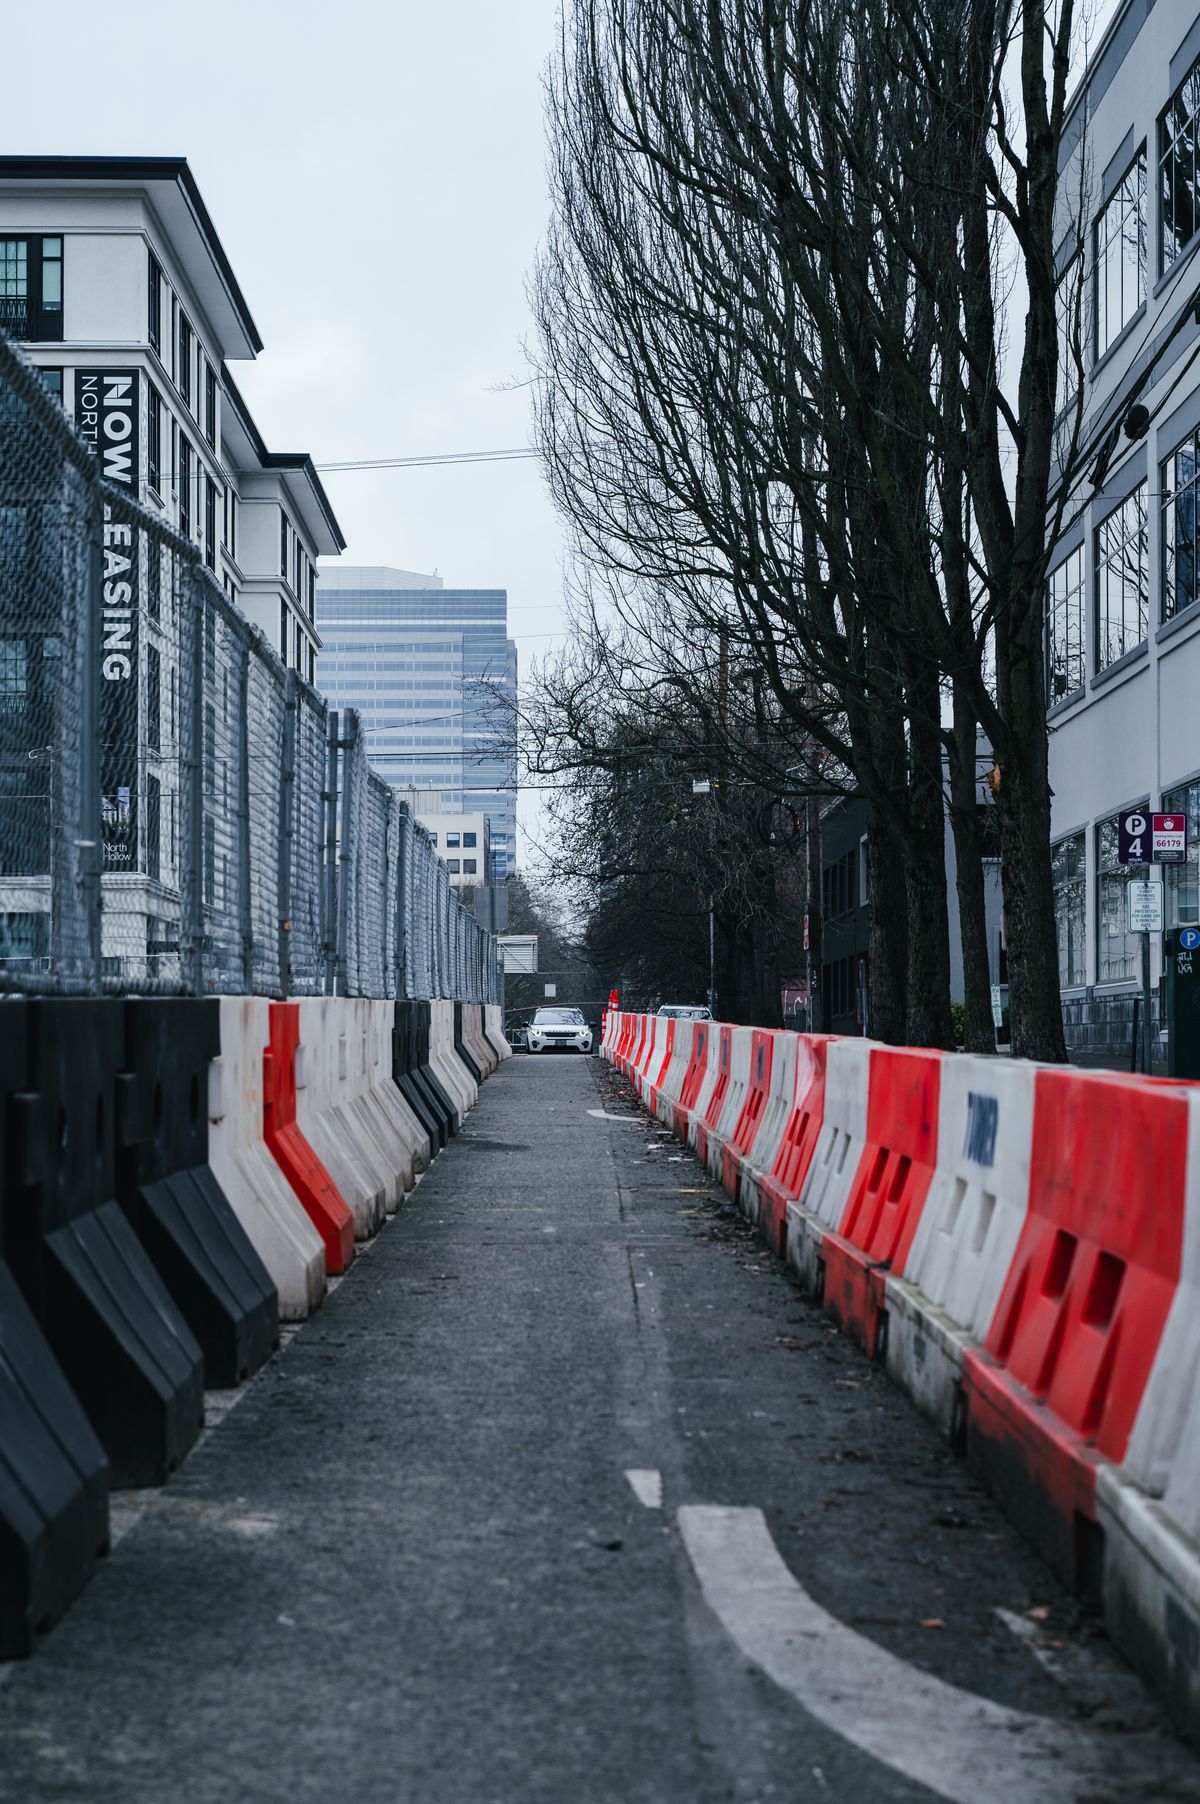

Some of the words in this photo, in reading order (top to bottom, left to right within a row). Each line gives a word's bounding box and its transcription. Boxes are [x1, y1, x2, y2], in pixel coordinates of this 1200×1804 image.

[103, 376, 132, 484] NOW
[103, 502, 132, 681] EASING
[1132, 818, 1141, 832] P
[103, 843, 127, 852] North
[1128, 838, 1142, 857] 4
[1156, 839, 1181, 847] 66179
[103, 852, 131, 860] Hollow
[1187, 932, 1196, 946] P
